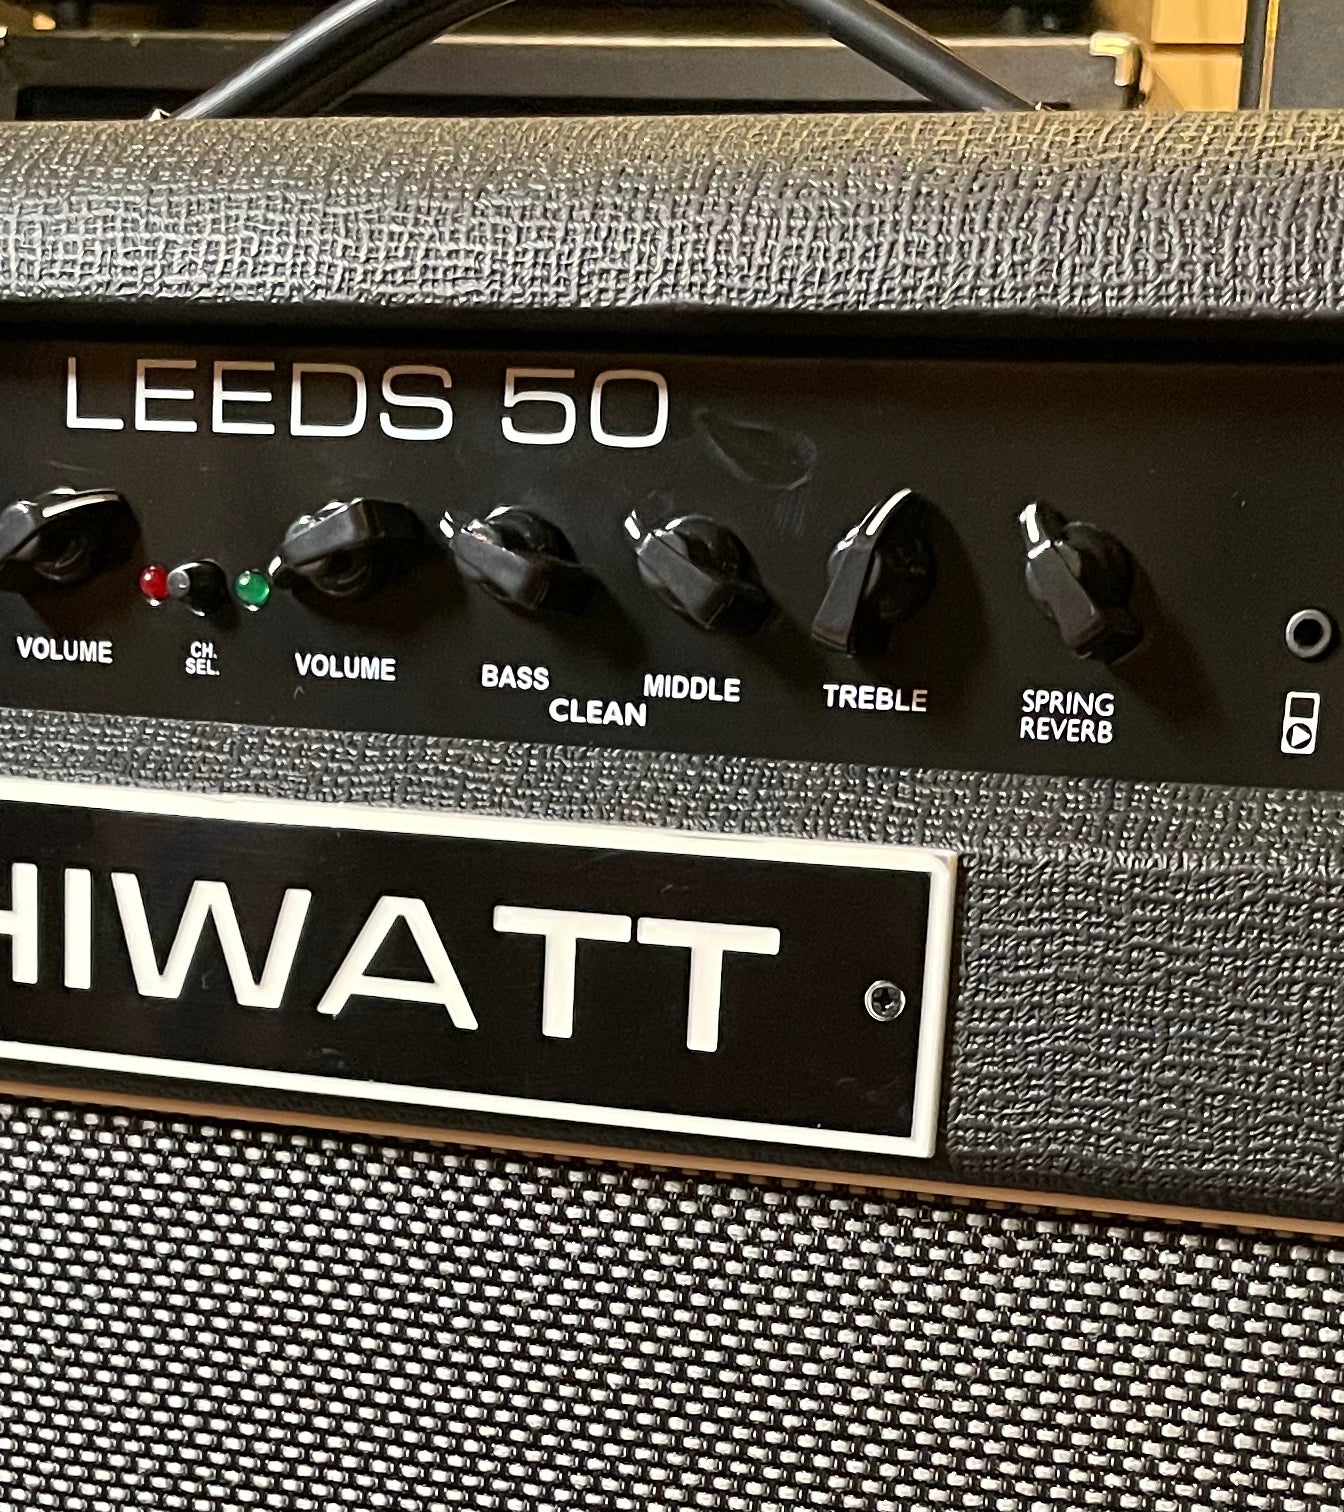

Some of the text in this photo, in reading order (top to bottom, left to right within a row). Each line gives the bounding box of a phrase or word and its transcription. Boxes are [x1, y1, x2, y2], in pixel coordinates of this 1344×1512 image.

[66, 356, 669, 449] LEEDS 50
[16, 635, 113, 664] VOLUME
[190, 640, 218, 660] CH.
[185, 658, 220, 677] SEL.
[294, 652, 396, 682] VOLUME
[481, 663, 549, 691] BASS
[643, 673, 741, 703] MIDDLE
[822, 683, 928, 712] TREBLE
[1021, 688, 1115, 717] SPRING
[548, 697, 647, 728] CLEAN
[1019, 716, 1113, 744] REVERB
